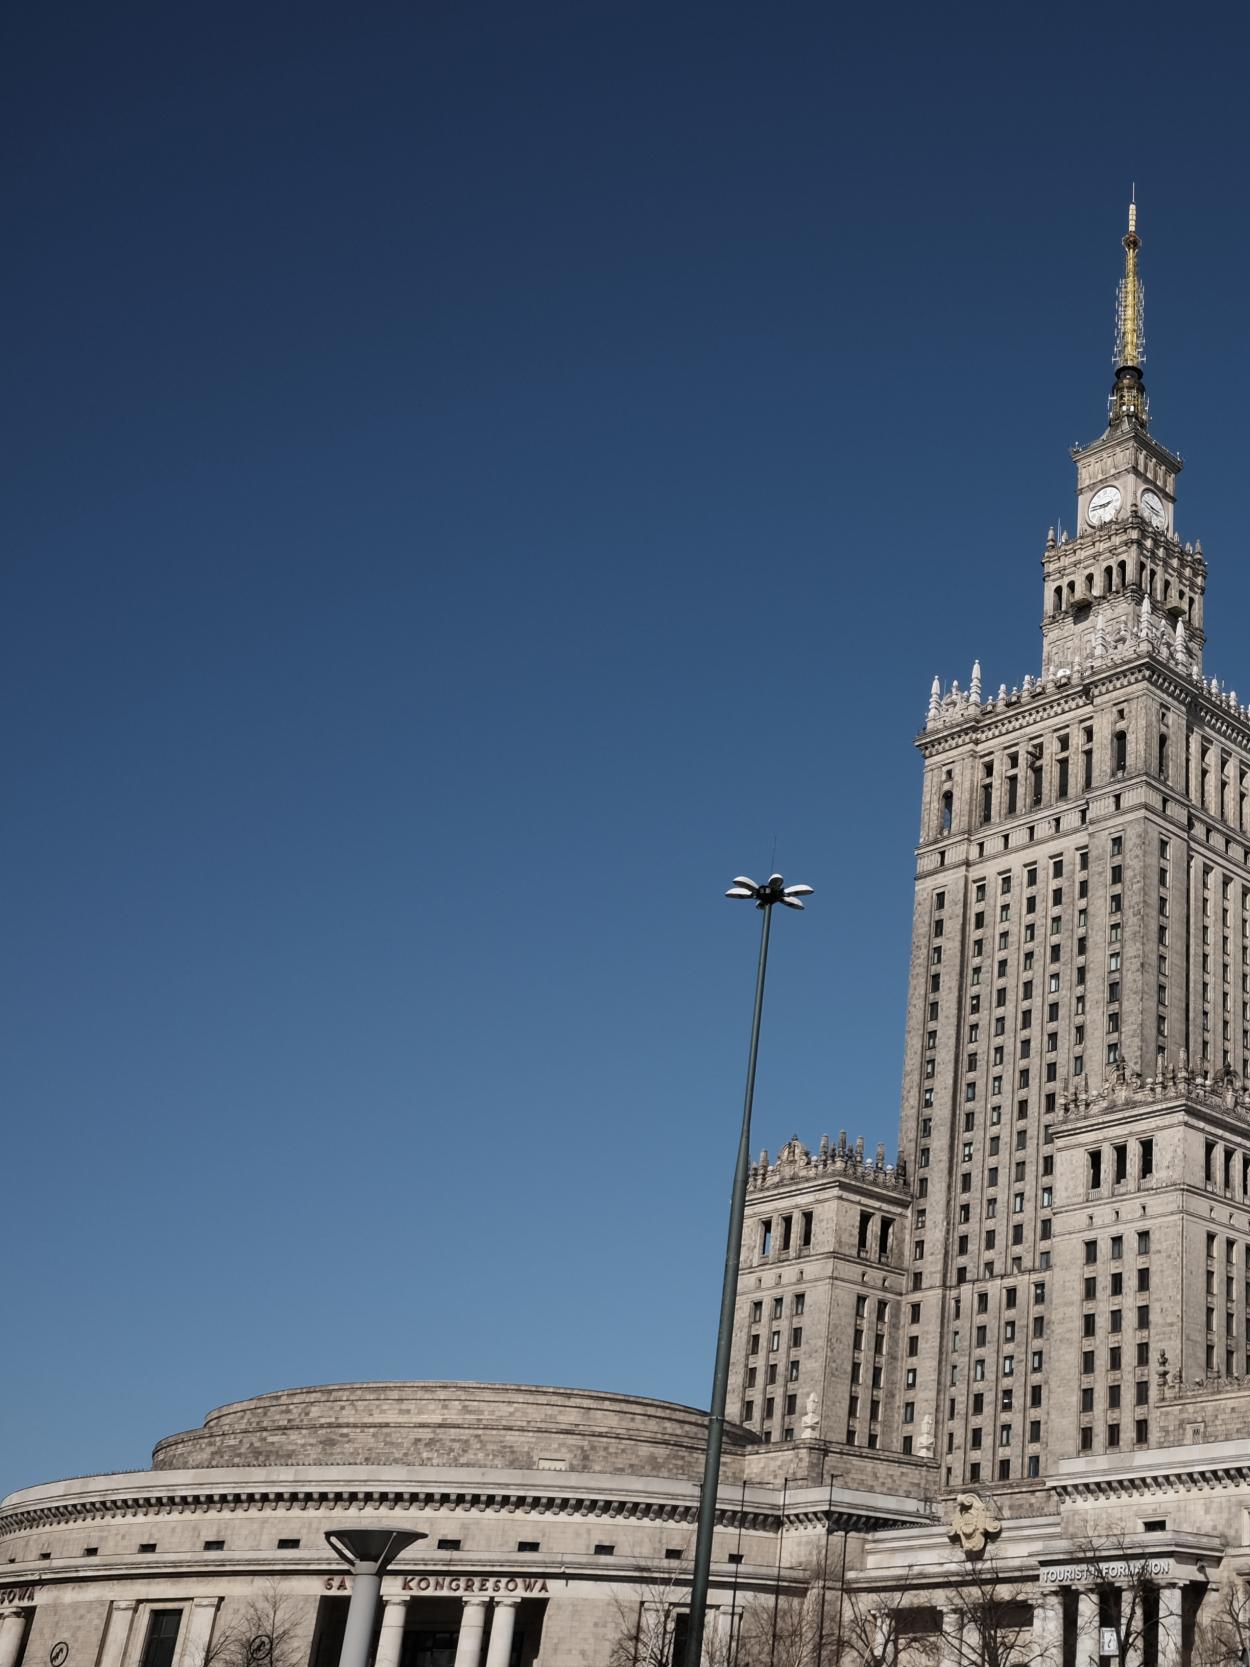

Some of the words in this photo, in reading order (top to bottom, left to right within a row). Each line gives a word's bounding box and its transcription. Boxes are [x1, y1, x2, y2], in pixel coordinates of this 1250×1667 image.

[1042, 1566, 1088, 1582] TOURIST
[325, 1576, 348, 1591] SA
[402, 1576, 549, 1593] KONGRESOWA
